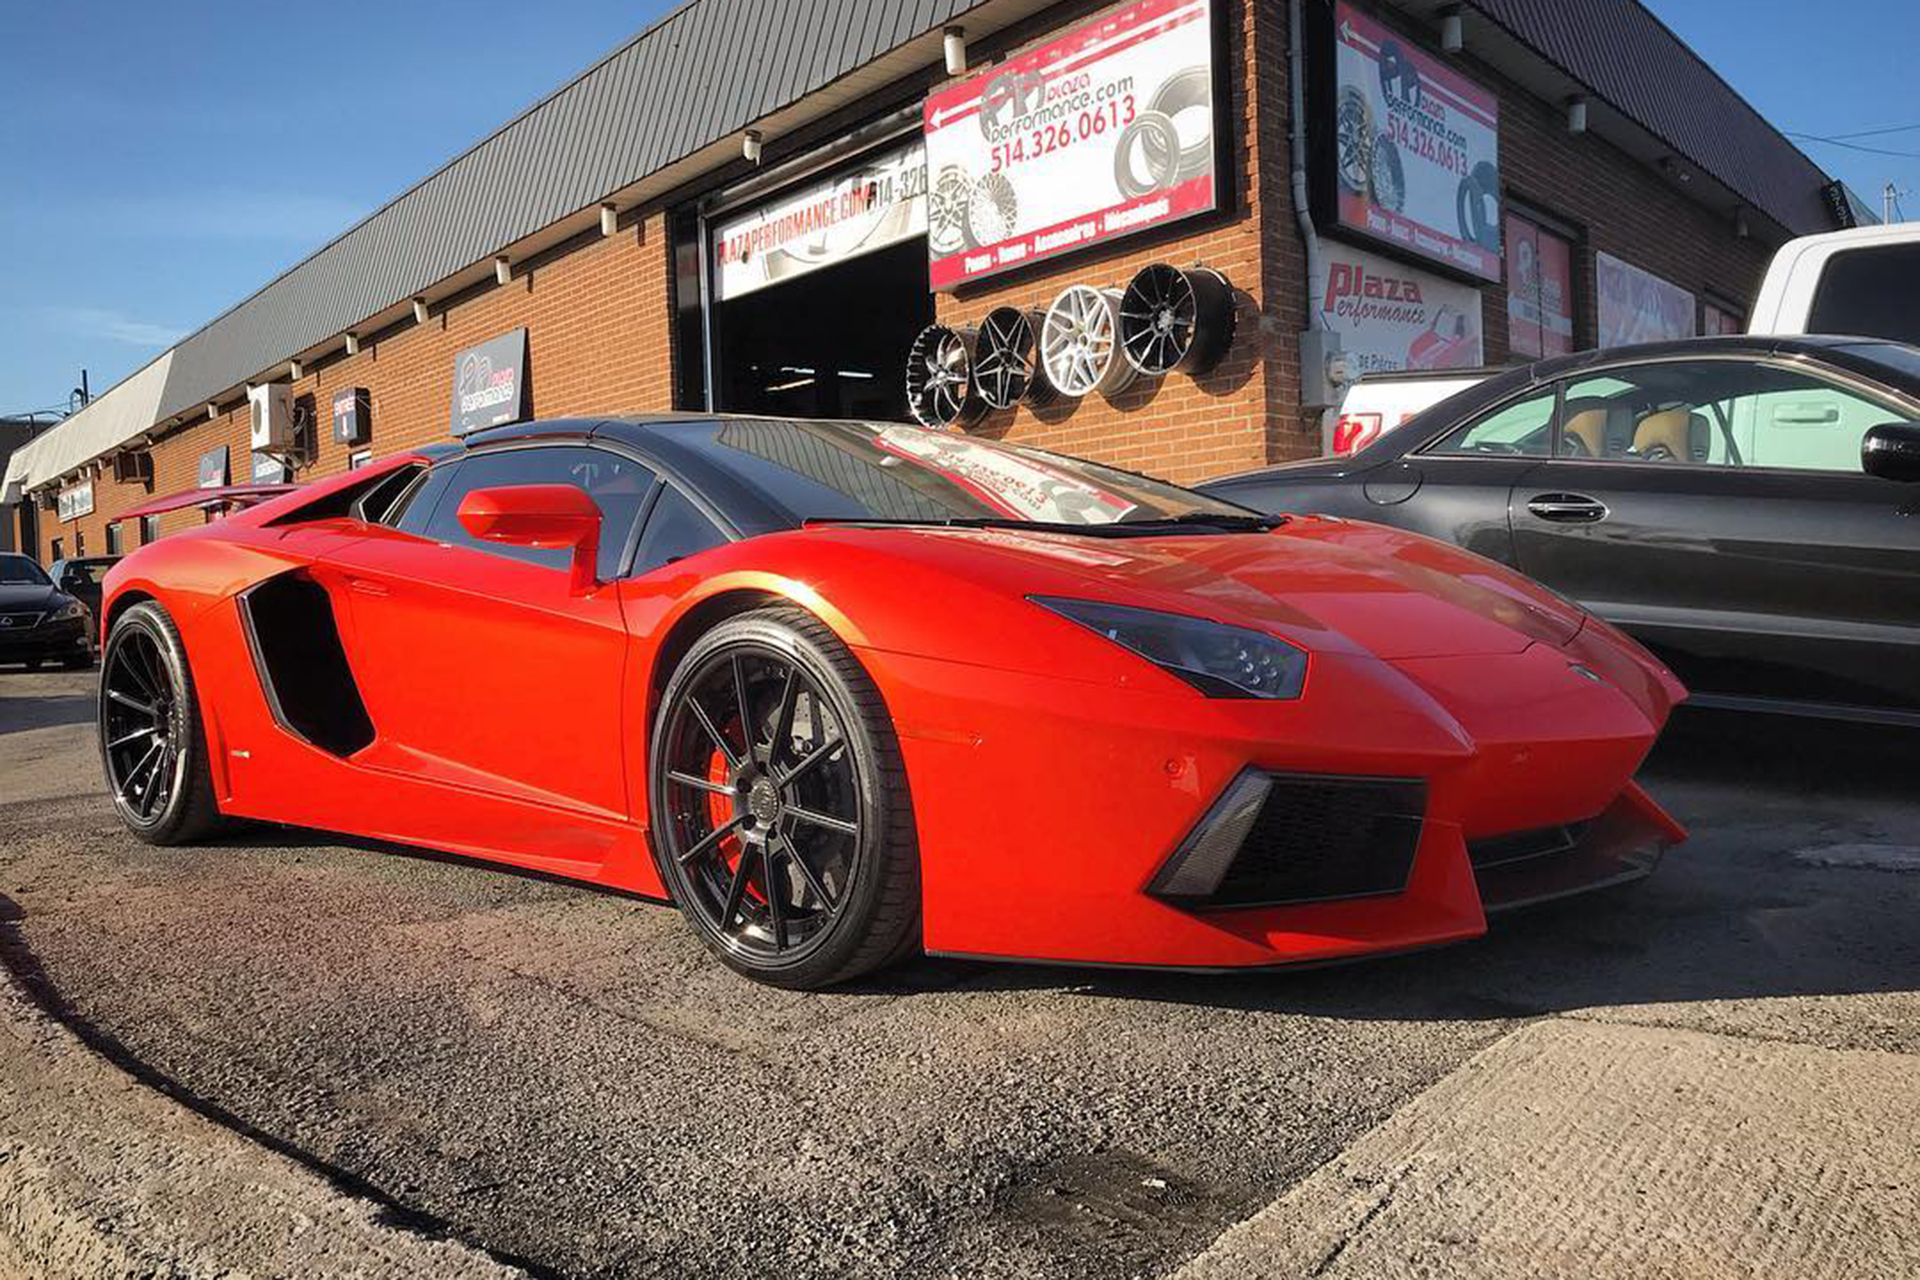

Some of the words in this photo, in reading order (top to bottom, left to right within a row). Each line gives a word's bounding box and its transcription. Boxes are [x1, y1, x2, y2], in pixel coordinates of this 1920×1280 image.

[1047, 73, 1090, 102] plaza
[991, 94, 1135, 173] 514.326.0613
[1387, 111, 1467, 176] 514.326.0613
